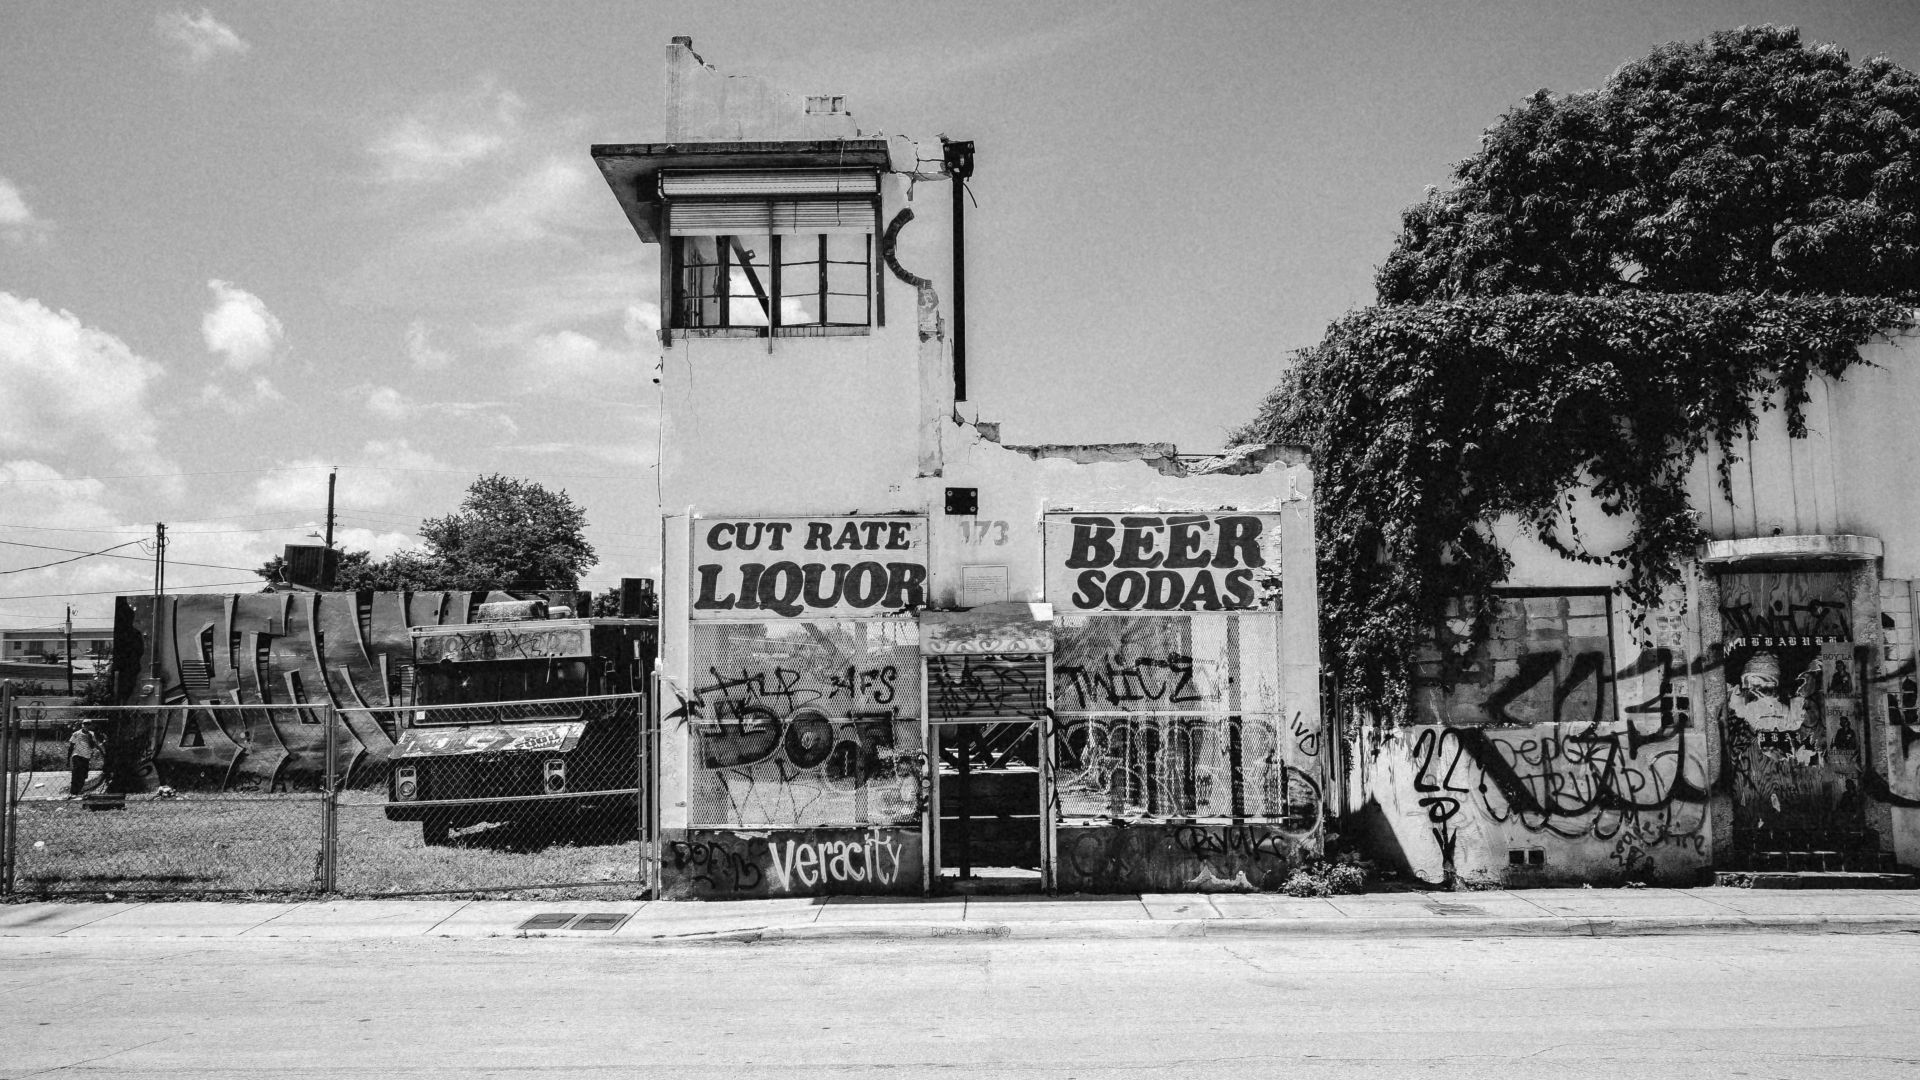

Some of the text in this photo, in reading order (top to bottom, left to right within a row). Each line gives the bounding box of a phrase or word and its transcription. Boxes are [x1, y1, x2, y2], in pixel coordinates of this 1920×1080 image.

[707, 521, 912, 551] CUT RATE
[959, 520, 1010, 546] 173
[1065, 515, 1266, 569] BEER
[694, 560, 927, 617] LIQUOR
[1071, 568, 1256, 610] SODAS
[930, 926, 963, 938] BLACK
